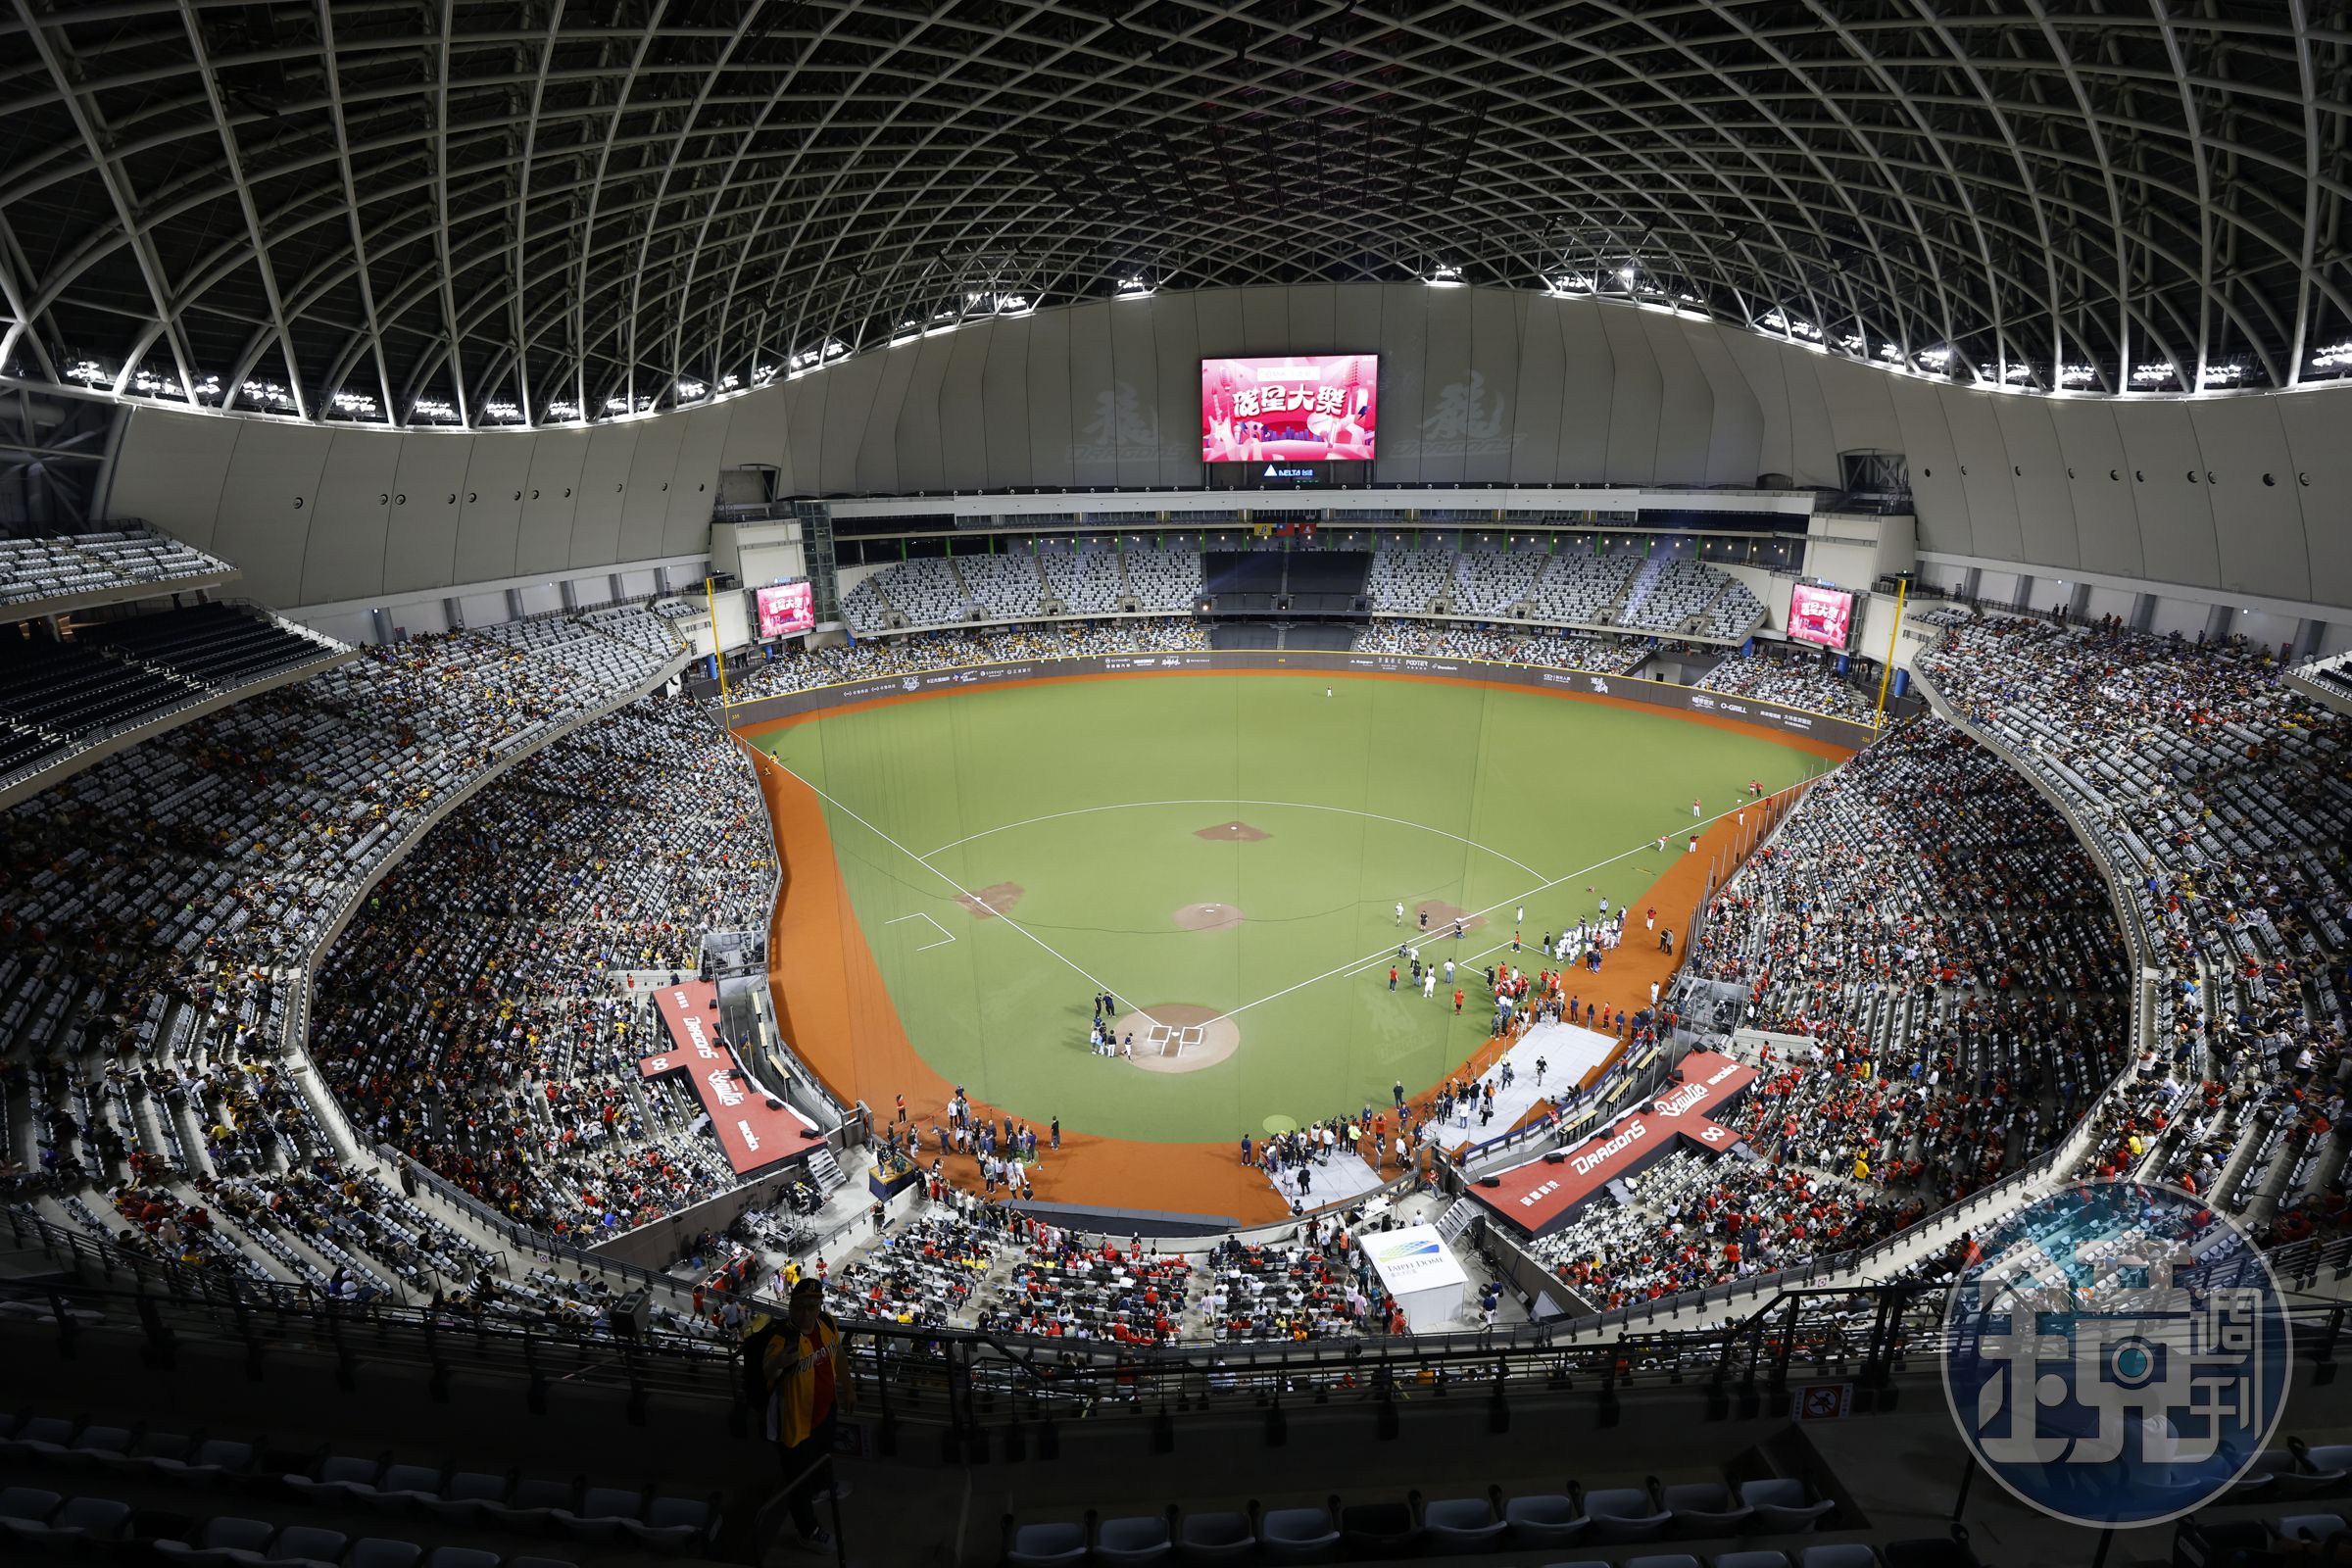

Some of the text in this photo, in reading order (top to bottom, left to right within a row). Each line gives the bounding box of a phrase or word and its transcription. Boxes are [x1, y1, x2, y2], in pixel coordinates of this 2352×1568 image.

[1720, 703, 1747, 713] O-GRILL
[683, 1016, 719, 1059] DRAGONS
[1653, 1083, 1709, 1116] Beauties
[1570, 1119, 1646, 1176] DRAGONS
[1388, 1256, 1445, 1272] TAIPEI DOME
